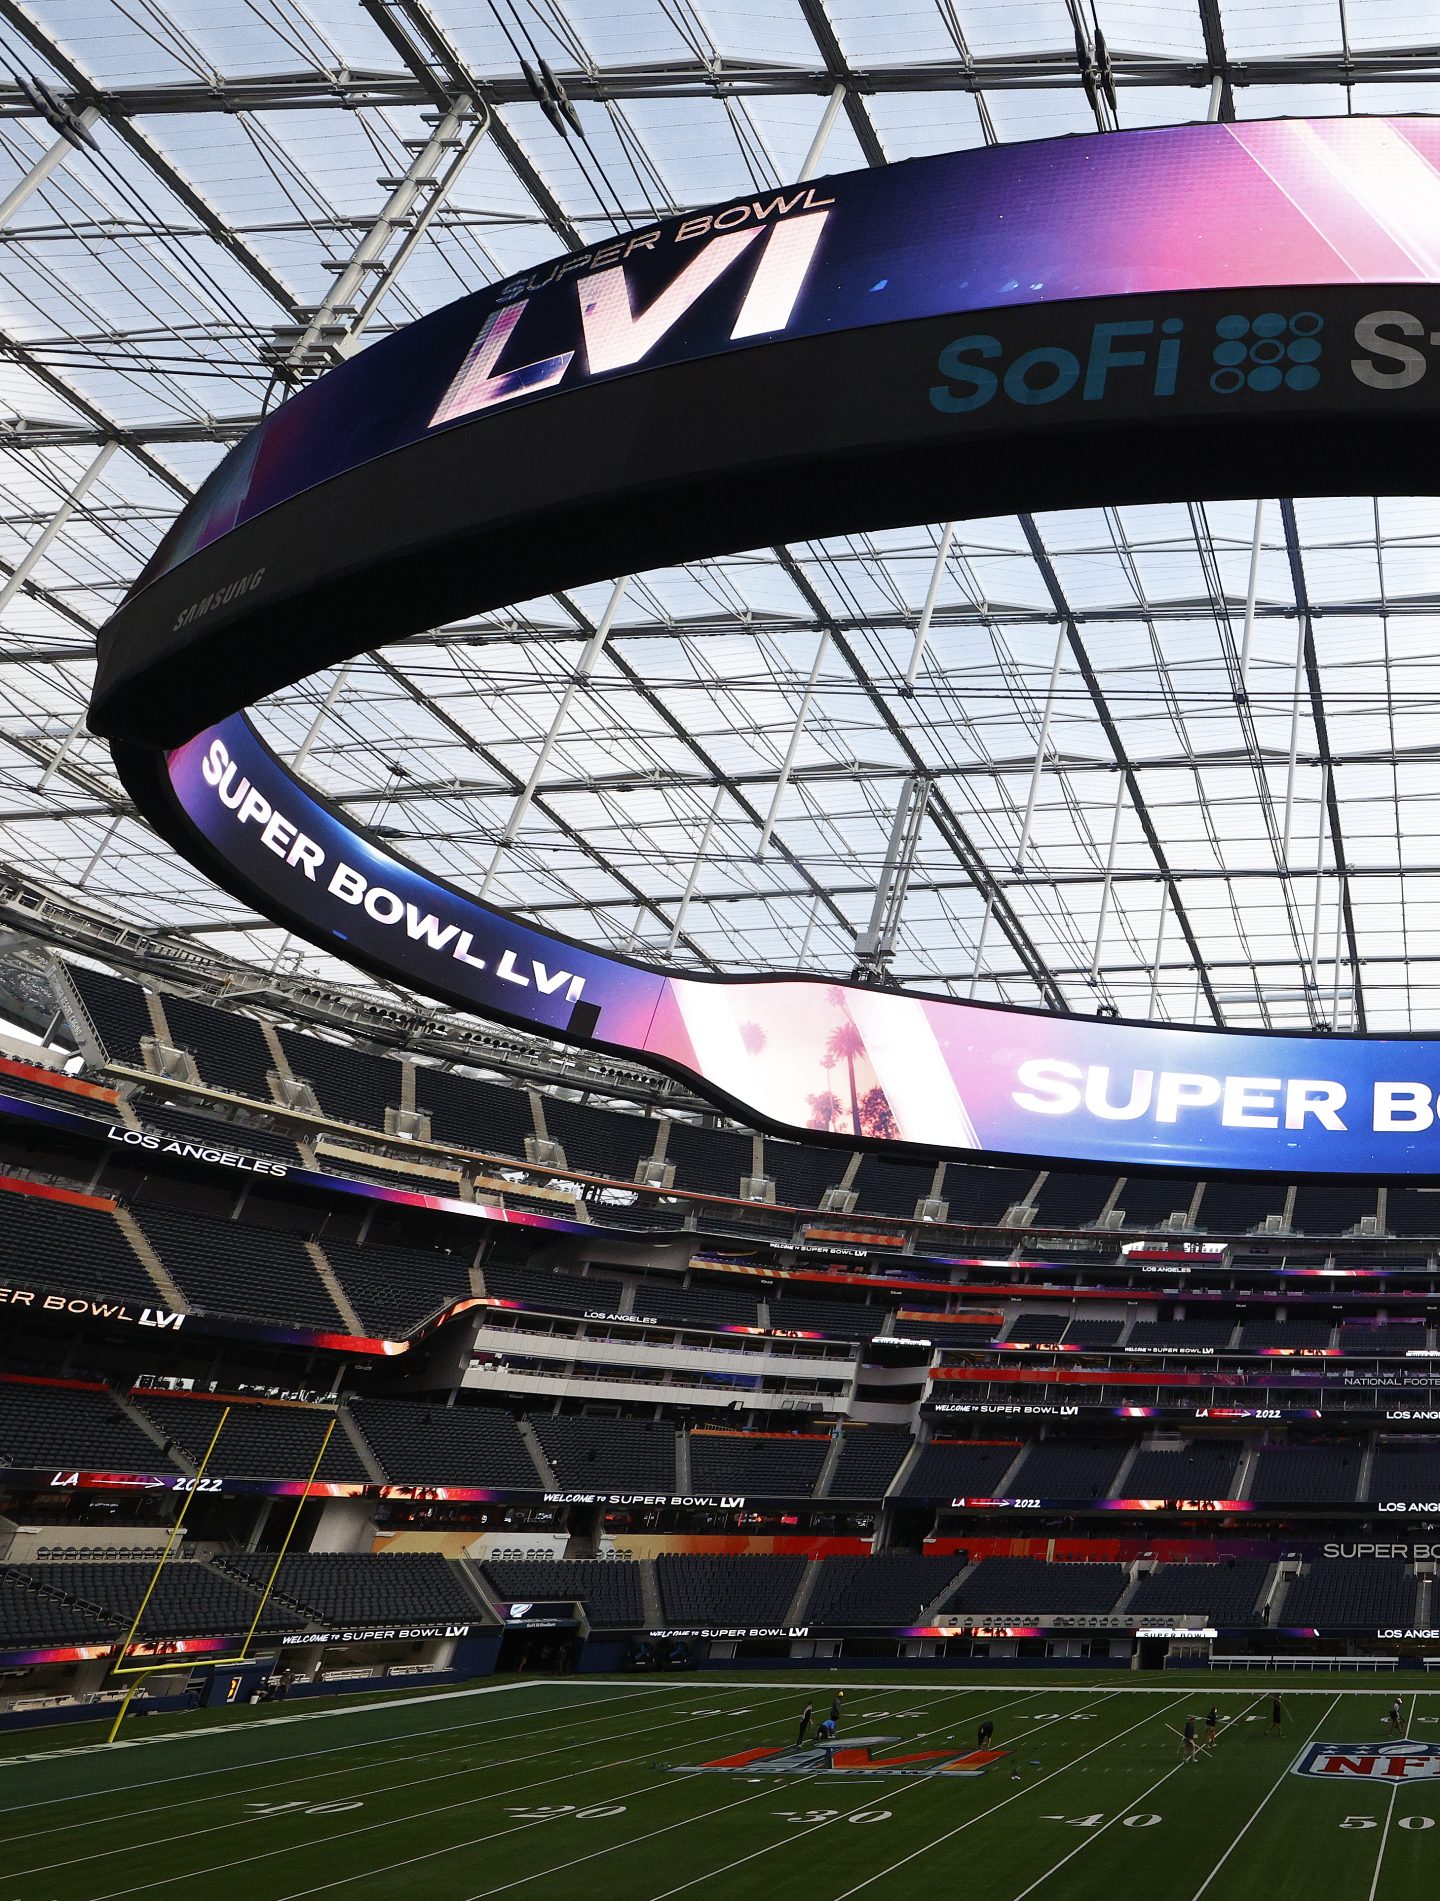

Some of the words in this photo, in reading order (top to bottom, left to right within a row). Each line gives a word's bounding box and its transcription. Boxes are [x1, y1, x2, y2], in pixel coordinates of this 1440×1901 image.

[496, 230, 661, 305] SUPER
[674, 188, 836, 244] BOWL
[428, 209, 830, 428] LVI
[929, 317, 1183, 414] SoFi
[174, 568, 265, 632] SAMSUNG
[202, 739, 326, 881] SUPER
[327, 862, 486, 969] BOWL
[496, 949, 586, 1004] LVI
[1011, 1059, 1347, 1131] SUPER
[107, 1126, 161, 1149] LOS
[162, 1142, 288, 1177] ANGELES
[43, 1295, 134, 1321] BOWL
[138, 1308, 186, 1330] LVI
[584, 1311, 606, 1319] LOS
[606, 1314, 658, 1324] ANGELES
[1344, 1378, 1402, 1386] NATIONAL
[935, 1404, 971, 1412] WELCOME
[980, 1405, 1021, 1413] SUPER
[1024, 1406, 1058, 1414] BOWL
[1060, 1406, 1079, 1415] LVI
[1195, 1409, 1209, 1418] LA
[1255, 1410, 1282, 1418] 2022
[1386, 1411, 1411, 1419] LOS
[50, 1471, 79, 1486] LA
[172, 1477, 223, 1492] 2022
[543, 1493, 595, 1503] WELCOME
[609, 1495, 667, 1505] SUPER
[670, 1497, 718, 1507] BOWL
[720, 1497, 745, 1508] LVI
[951, 1498, 966, 1507] LA
[1014, 1499, 1041, 1508] 2022
[1378, 1502, 1407, 1512] LOS
[1323, 1543, 1408, 1558] SUPER
[282, 1633, 329, 1645] WELCOME
[342, 1630, 394, 1641] SUPER
[398, 1628, 443, 1638] BOWL
[445, 1626, 469, 1637] LVI
[701, 1629, 746, 1637] SUPER
[749, 1628, 787, 1636] BOWL
[789, 1627, 809, 1637] LVI
[1377, 1629, 1403, 1638] LOS
[243, 1801, 364, 1815] 10
[509, 1804, 627, 1819] 20
[786, 1809, 893, 1824] 30
[1064, 1813, 1162, 1827] 40
[1338, 1815, 1436, 1830] 50
